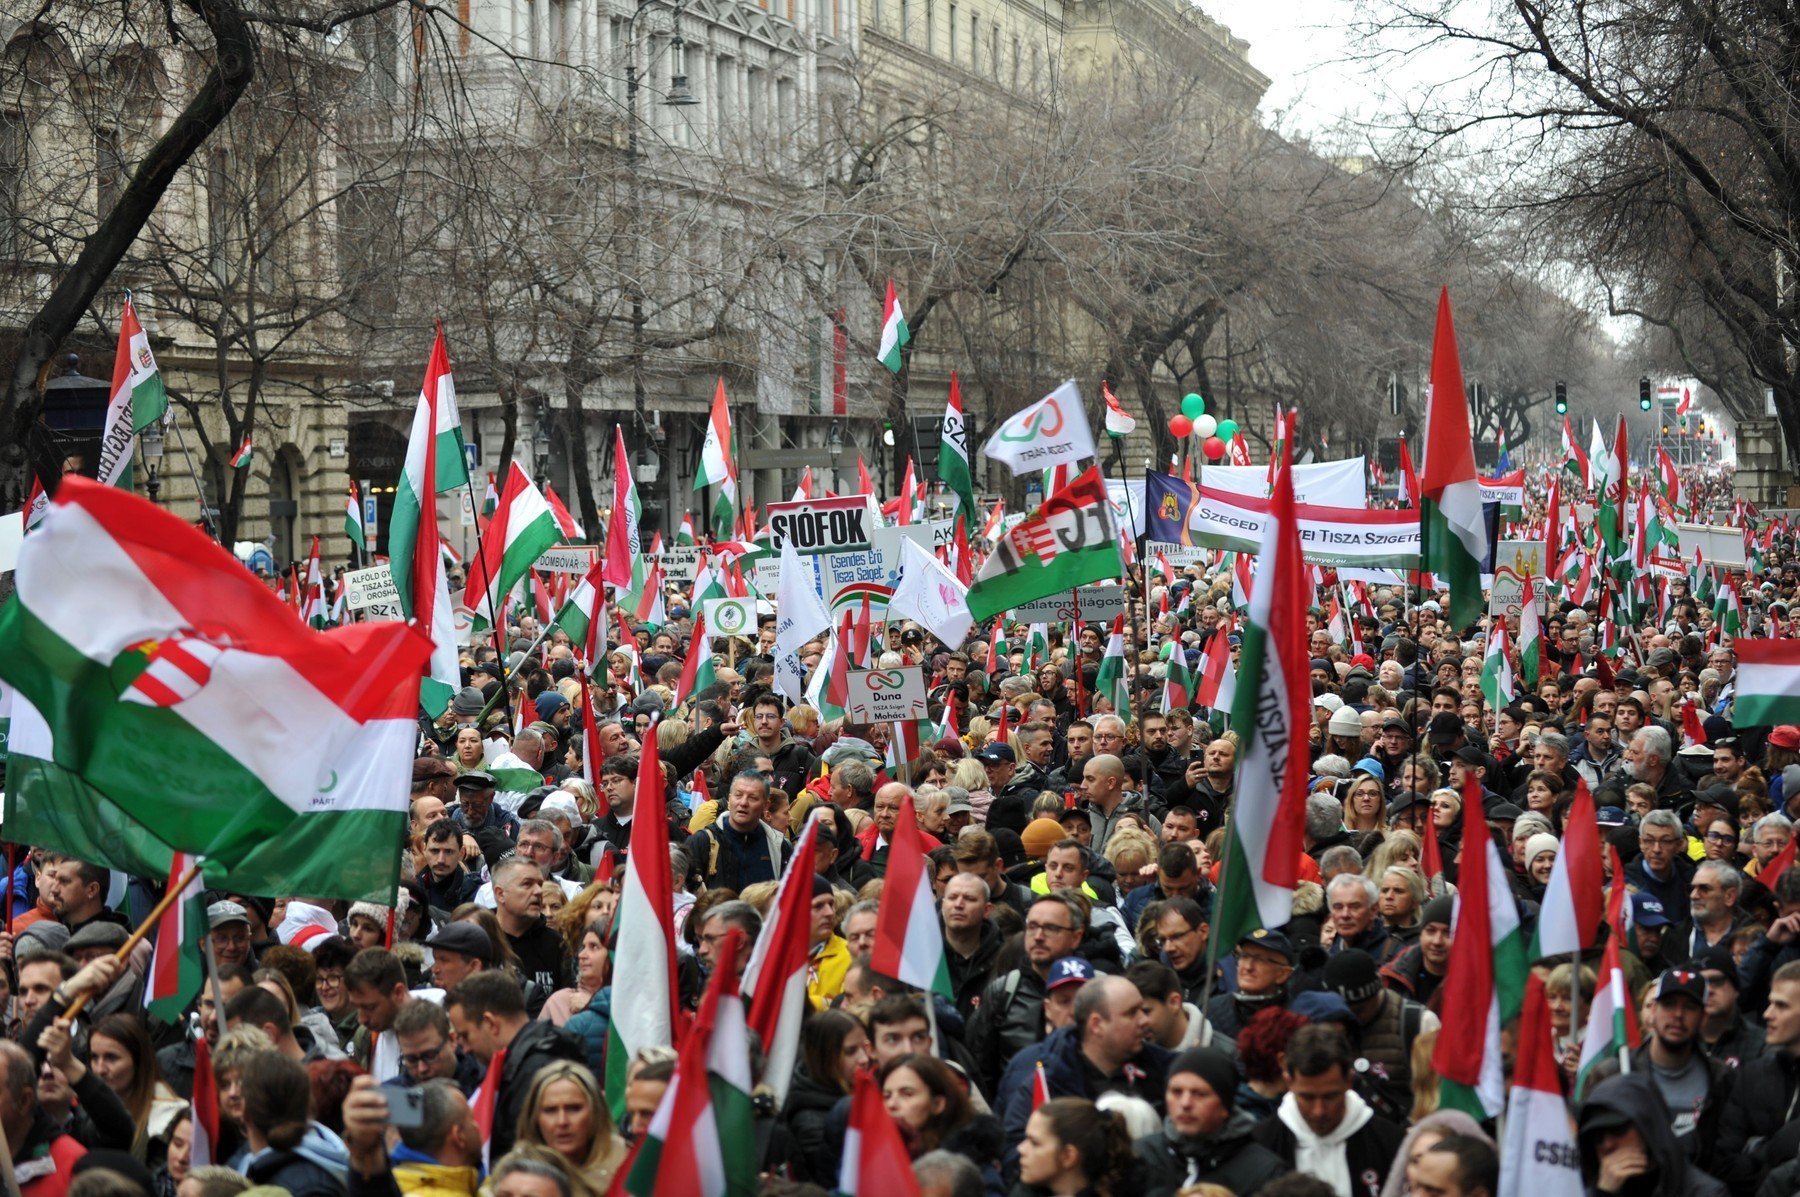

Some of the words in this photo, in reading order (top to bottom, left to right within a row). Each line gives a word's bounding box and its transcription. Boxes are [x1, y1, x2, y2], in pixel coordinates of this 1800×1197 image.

[771, 507, 868, 550] SIÓFOK
[1199, 507, 1259, 531] SZEGED
[1317, 529, 1361, 545] TISZA
[539, 554, 580, 569] DOMBÓVÁR
[830, 553, 867, 569] Csendes
[1302, 554, 1347, 564] dfenyei.eu
[351, 572, 380, 584] ALFÖLD
[832, 569, 855, 583] Tisza
[856, 567, 884, 583] Sziget
[362, 582, 382, 592] TISZA
[366, 588, 400, 601] OROSHÁ
[873, 692, 902, 702] Duna
[874, 712, 906, 720] Mohács
